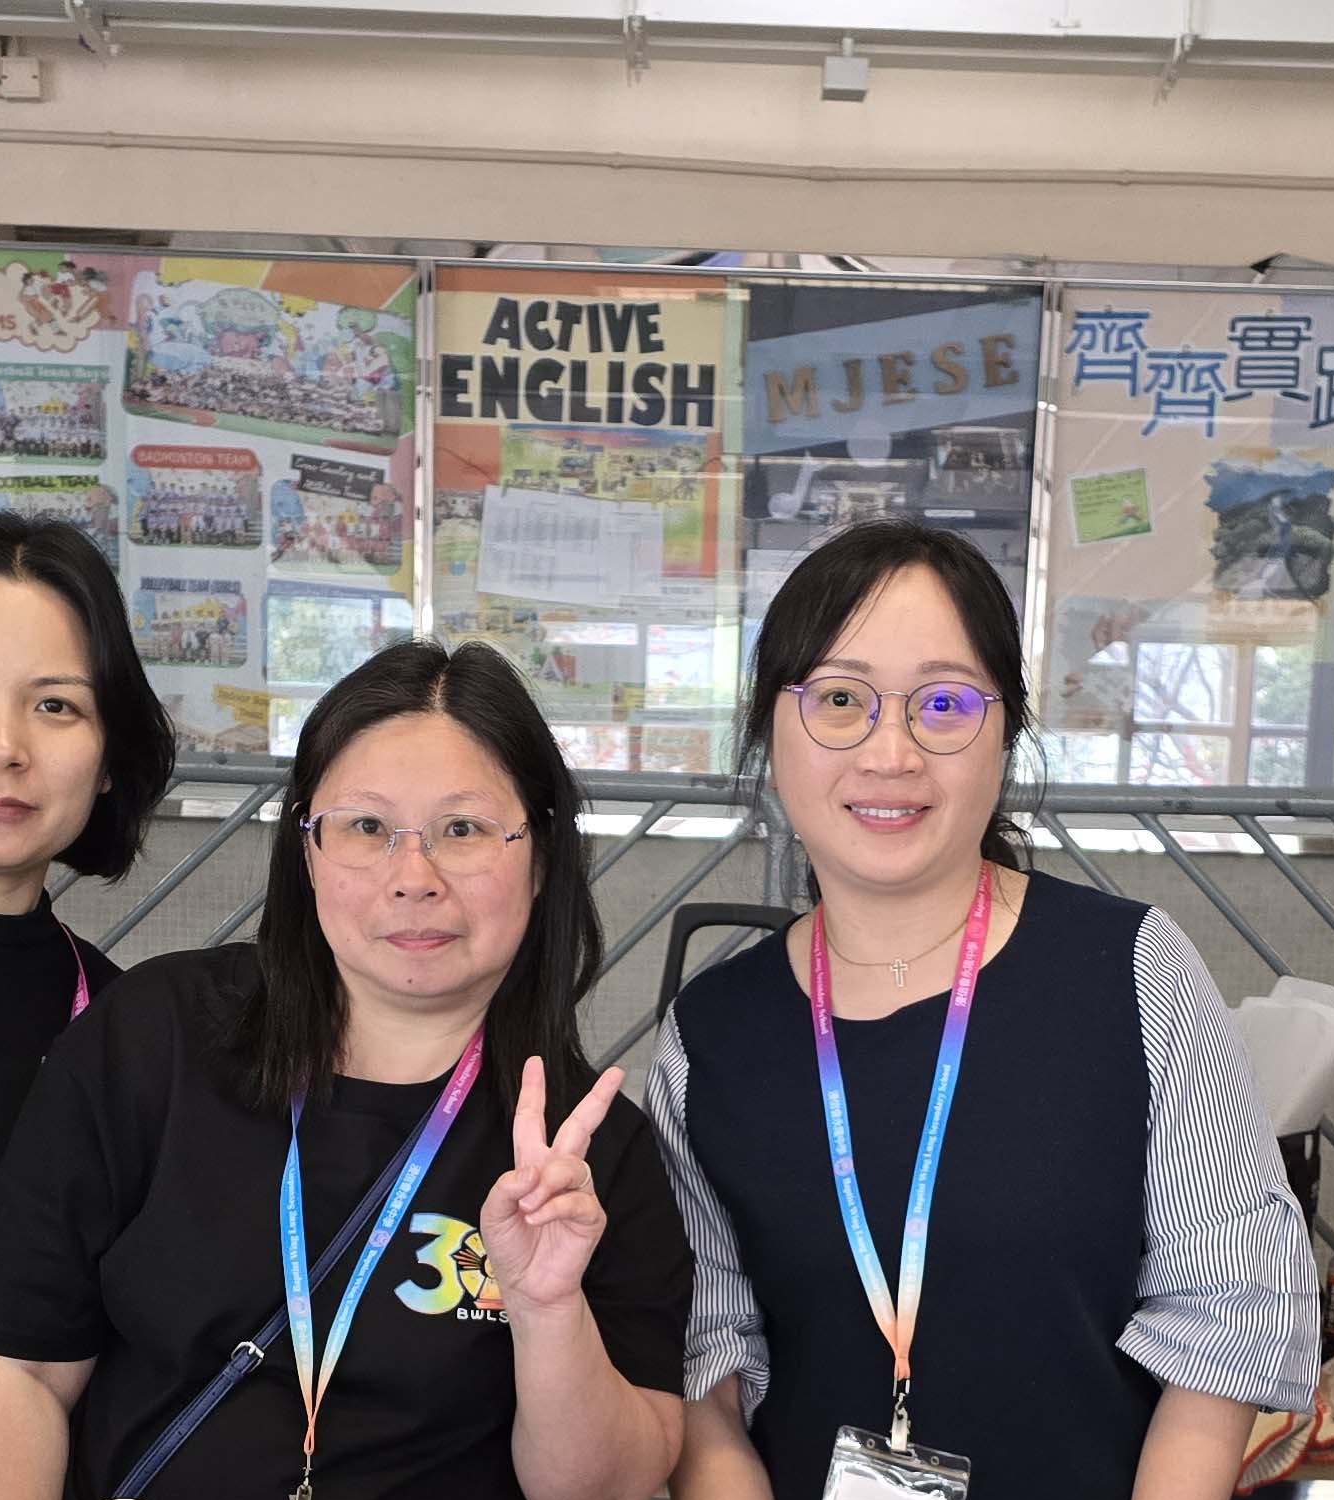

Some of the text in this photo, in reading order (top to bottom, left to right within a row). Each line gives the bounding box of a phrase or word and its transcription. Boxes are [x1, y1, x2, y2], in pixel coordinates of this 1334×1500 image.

[483, 297, 665, 353] ACTIVE
[439, 353, 716, 427] ENGLISH
[765, 334, 1021, 423] MJESE
[457, 1308, 509, 1323] BWLS
